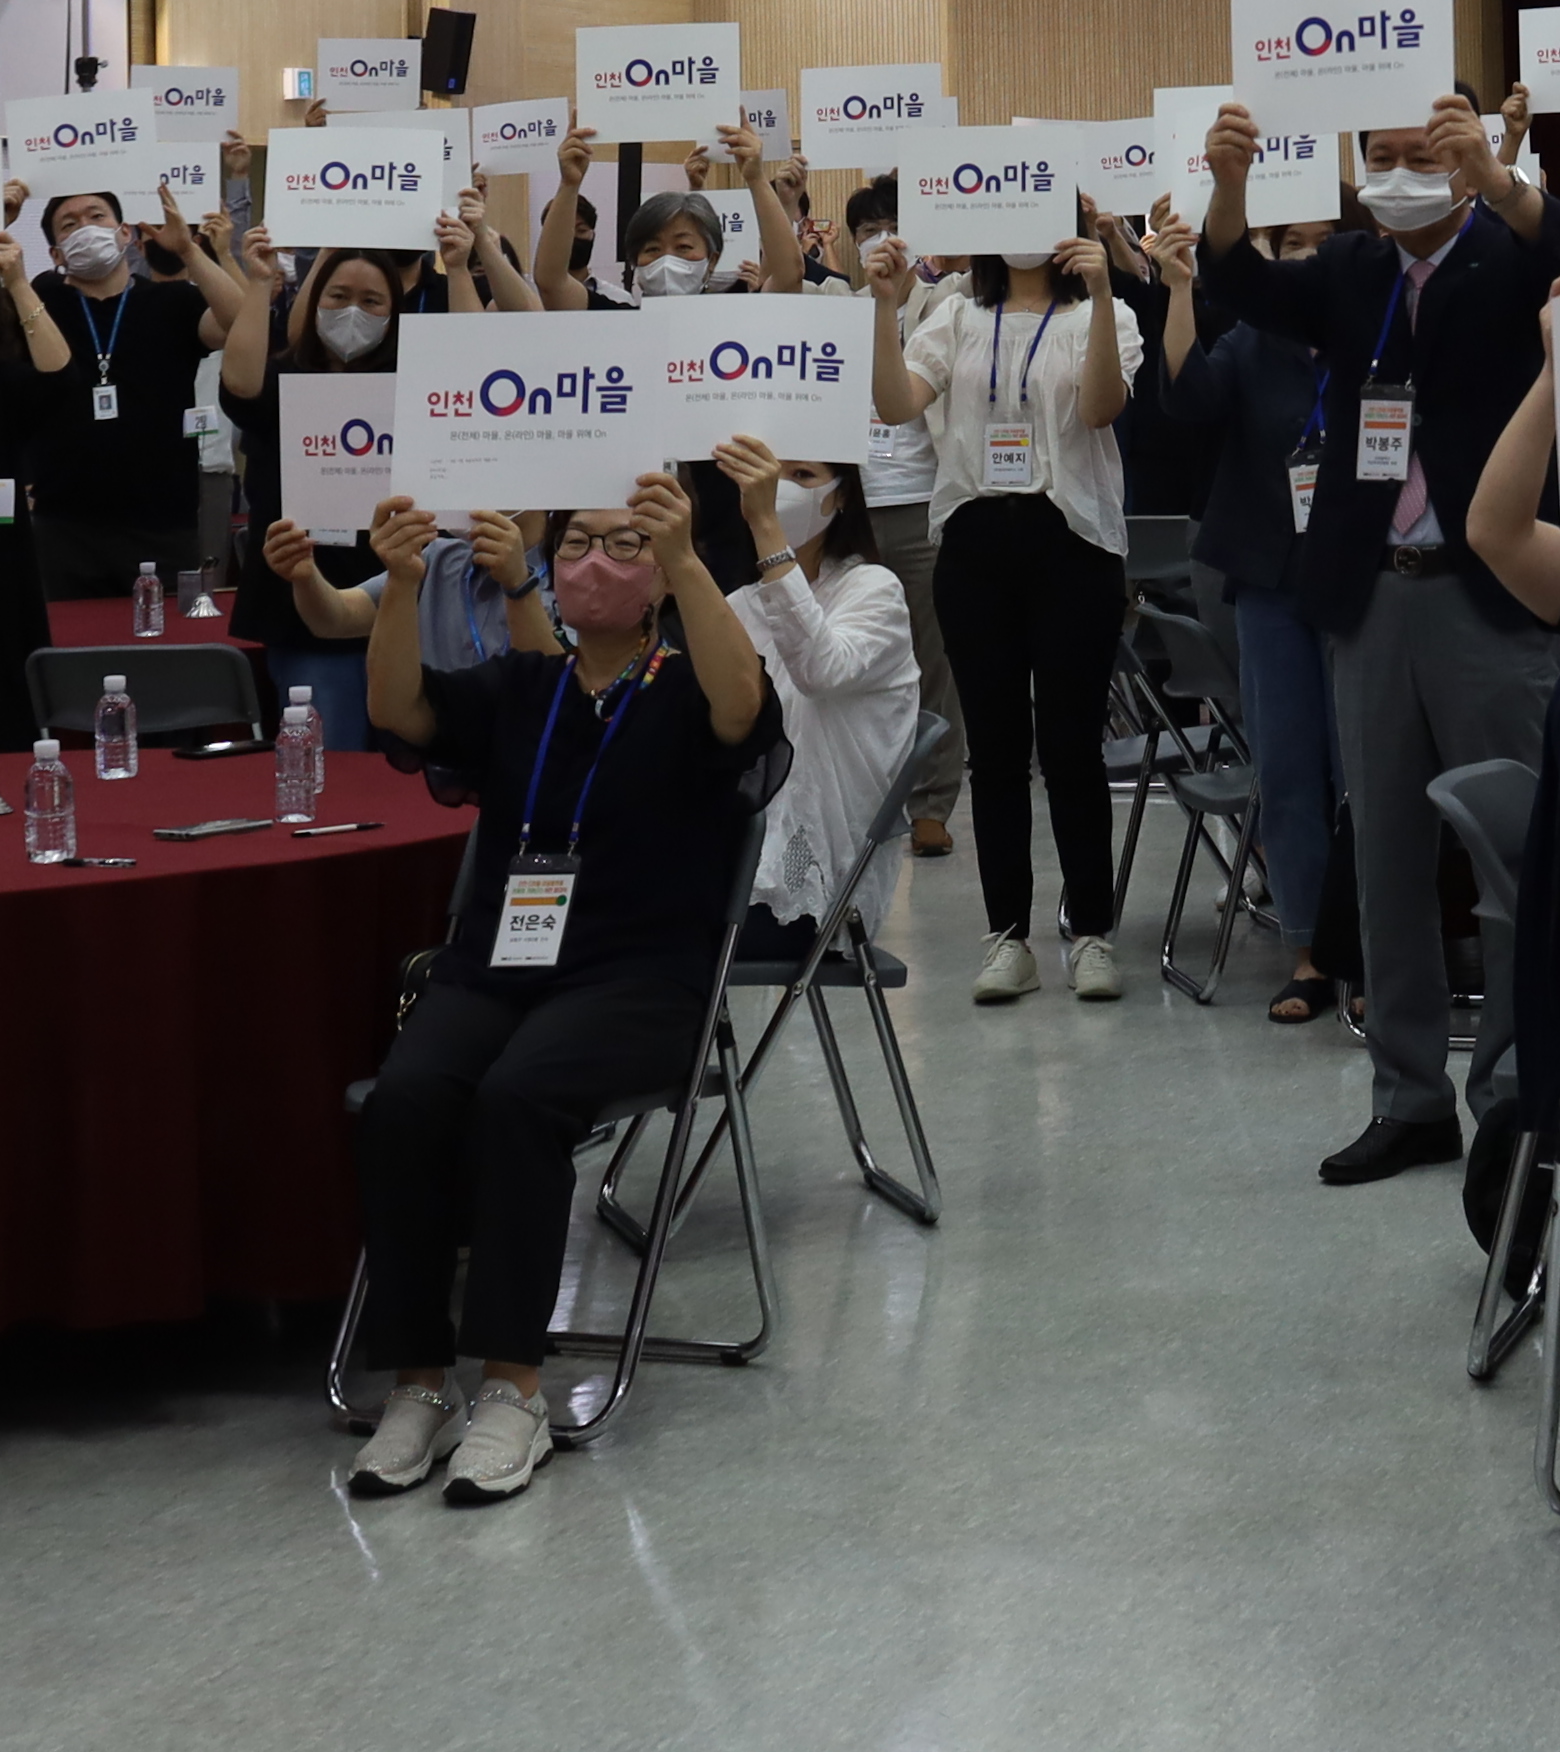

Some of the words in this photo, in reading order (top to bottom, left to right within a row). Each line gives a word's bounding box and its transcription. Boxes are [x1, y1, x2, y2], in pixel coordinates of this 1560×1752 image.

[1254, 36, 1291, 62] 인천
[667, 359, 704, 384] 인천
[427, 390, 474, 418] 인천
[1365, 436, 1403, 452] 박봉주
[991, 452, 1026, 464] 안예지
[509, 914, 557, 932] 전은숙
